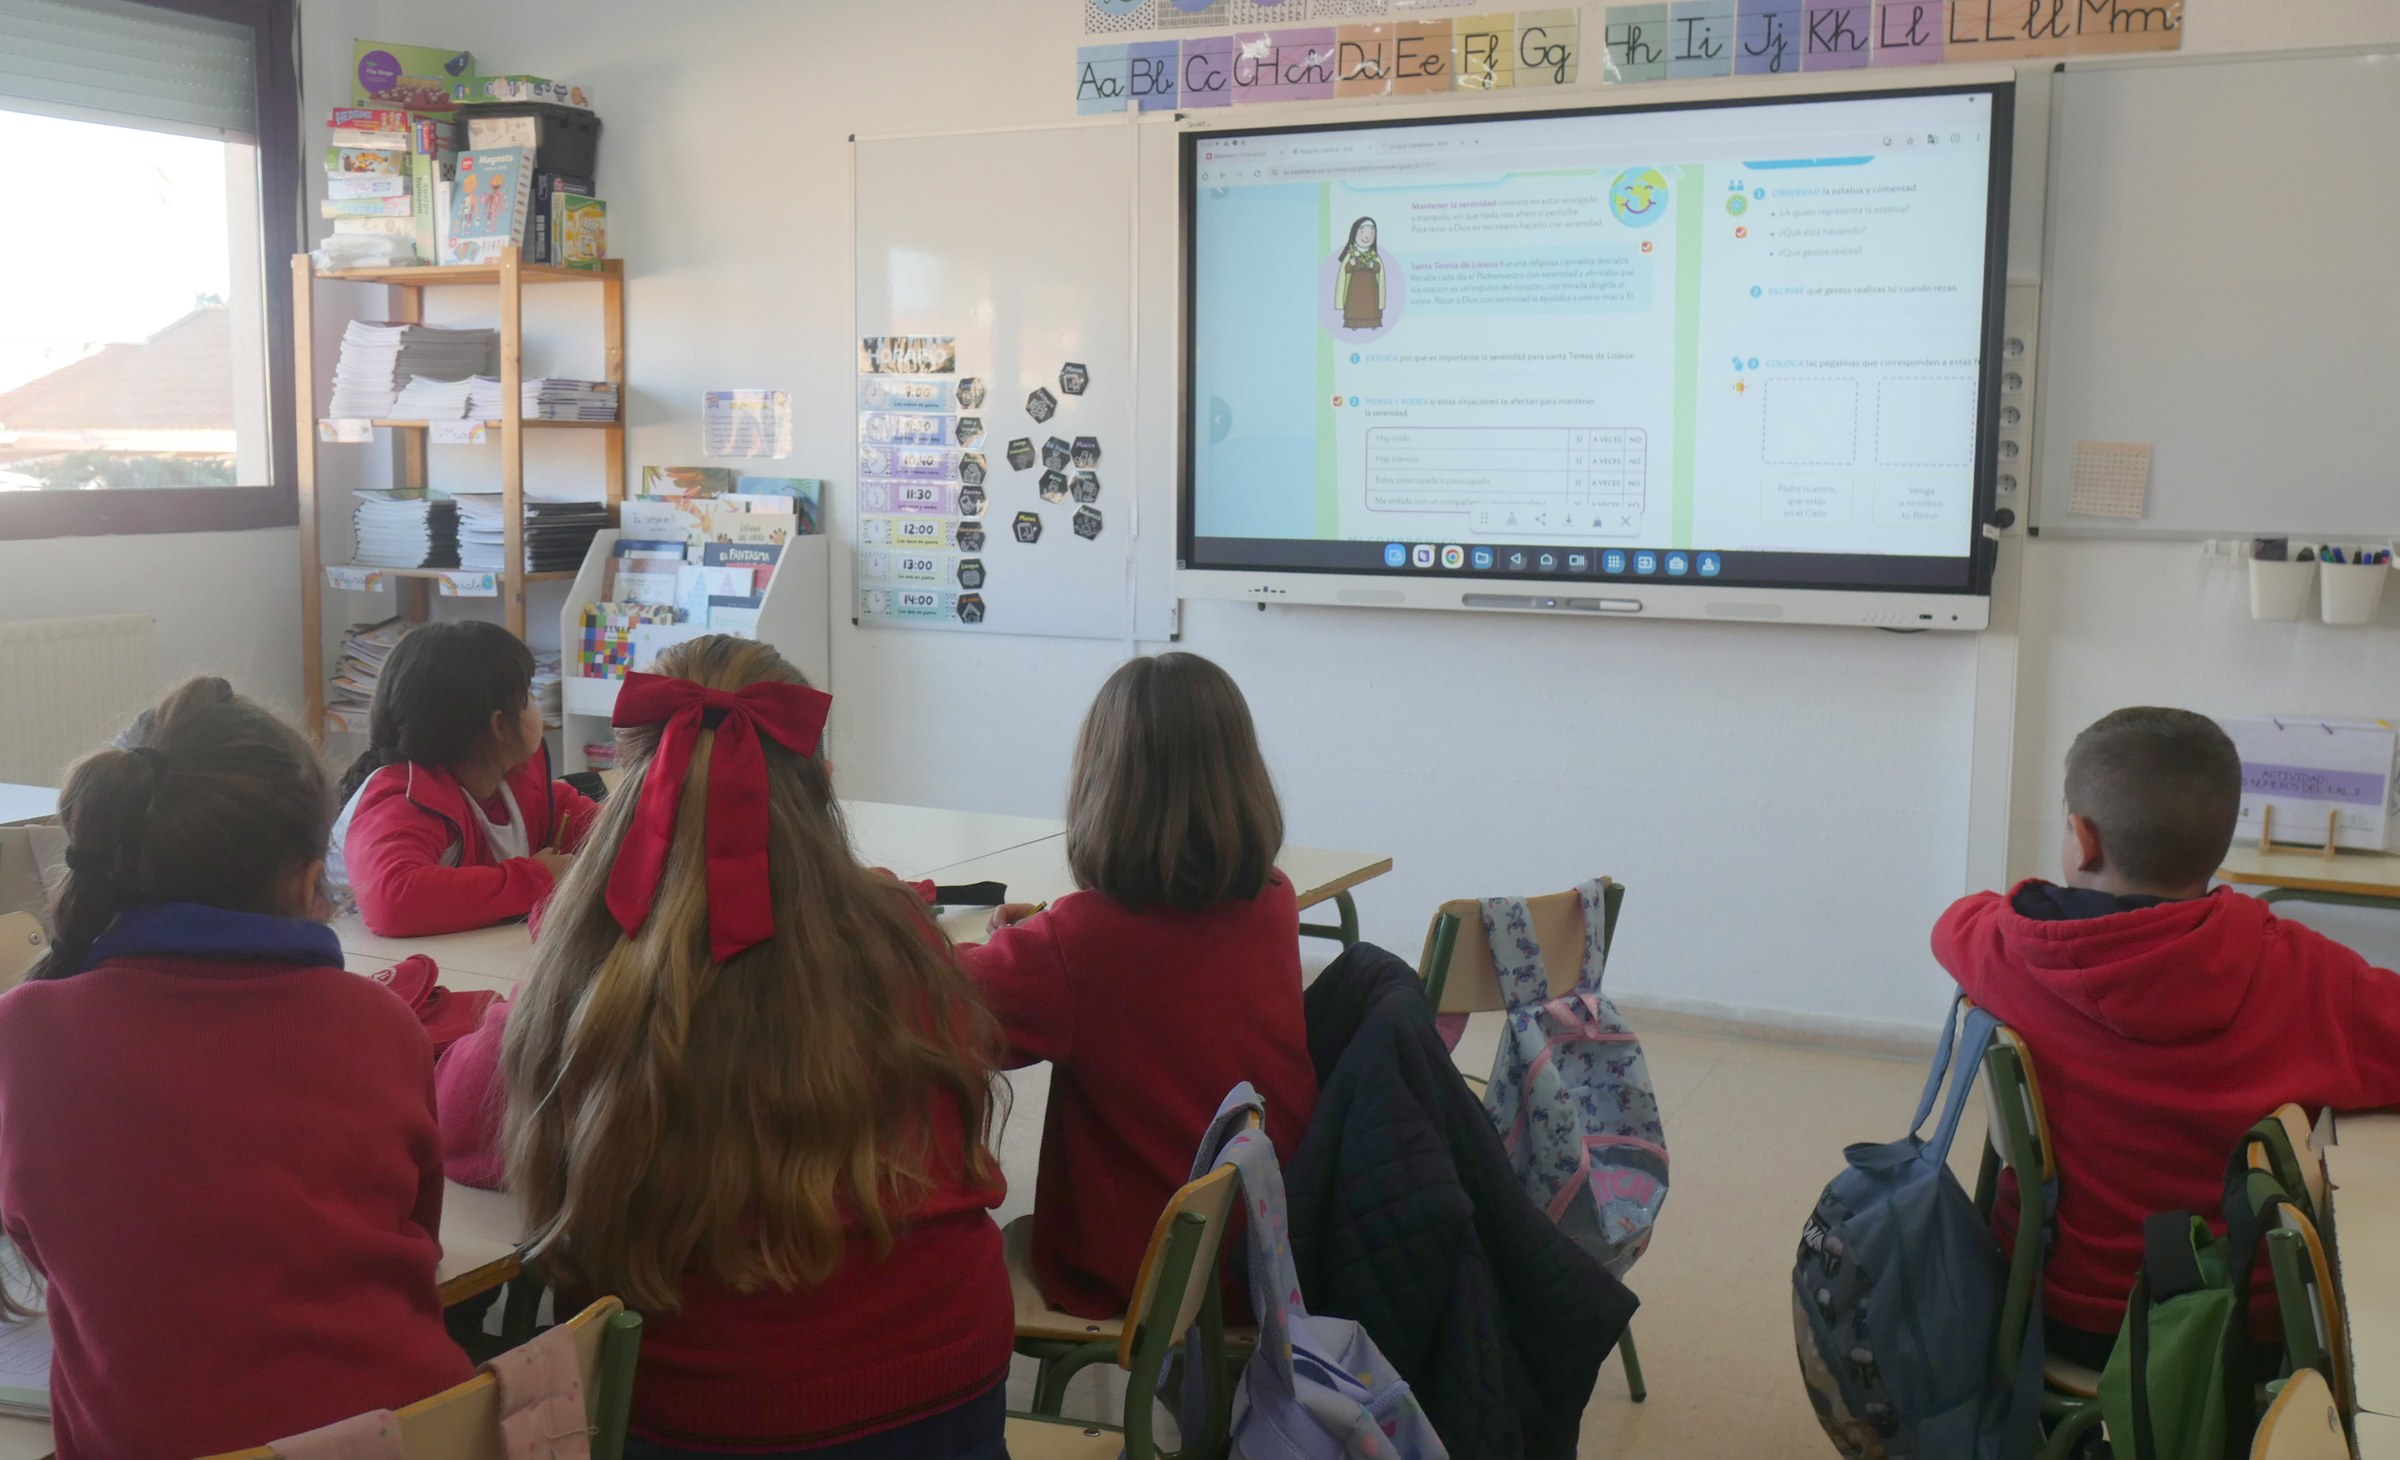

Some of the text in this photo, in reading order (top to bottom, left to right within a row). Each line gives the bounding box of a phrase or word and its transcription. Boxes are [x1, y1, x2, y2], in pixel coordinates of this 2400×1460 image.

[1675, 17, 1722, 60] Ii
[1745, 14, 1787, 73] Jj
[1808, 10, 1867, 53] Kk
[1881, 7, 1929, 47] Ll
[1077, 63, 1123, 100] Aa
[1130, 58, 1173, 96] Bb
[1186, 55, 1225, 93] Cc
[1339, 42, 1389, 81] Dd
[1398, 37, 1444, 77] Ee
[1464, 33, 1499, 88] Ff
[1520, 27, 1571, 84] Gg
[479, 155, 513, 166] Magnets
[1772, 189, 1820, 197] OBSERVAD
[1822, 187, 1830, 195] la
[1832, 187, 1863, 195] estatua
[1412, 201, 1448, 210] Mantener
[1459, 200, 1496, 208] serenidad
[1411, 262, 1432, 270] Santa
[1460, 261, 1470, 269] de
[1769, 287, 1804, 295] ESCRIBE
[1825, 287, 1851, 297] gestos
[1853, 286, 1885, 294] realizas
[1899, 284, 1931, 293] cuando
[1400, 355, 1412, 364] por
[1439, 353, 1480, 363] importante
[1489, 352, 1526, 360] serenidad
[1528, 354, 1543, 362] para
[1569, 351, 1593, 360] Teresa
[1596, 351, 1605, 359] de
[1766, 359, 1804, 368] COLOCA
[1806, 358, 1817, 367] las
[1820, 359, 1860, 369] pegatinas
[1863, 359, 1878, 368] que
[1365, 409, 1371, 417] la
[907, 489, 932, 499] 11:30
[905, 524, 934, 534] 12:00
[719, 548, 769, 561] EL FANTASMA
[904, 559, 932, 570] 13:00
[905, 595, 933, 605] 14:00
